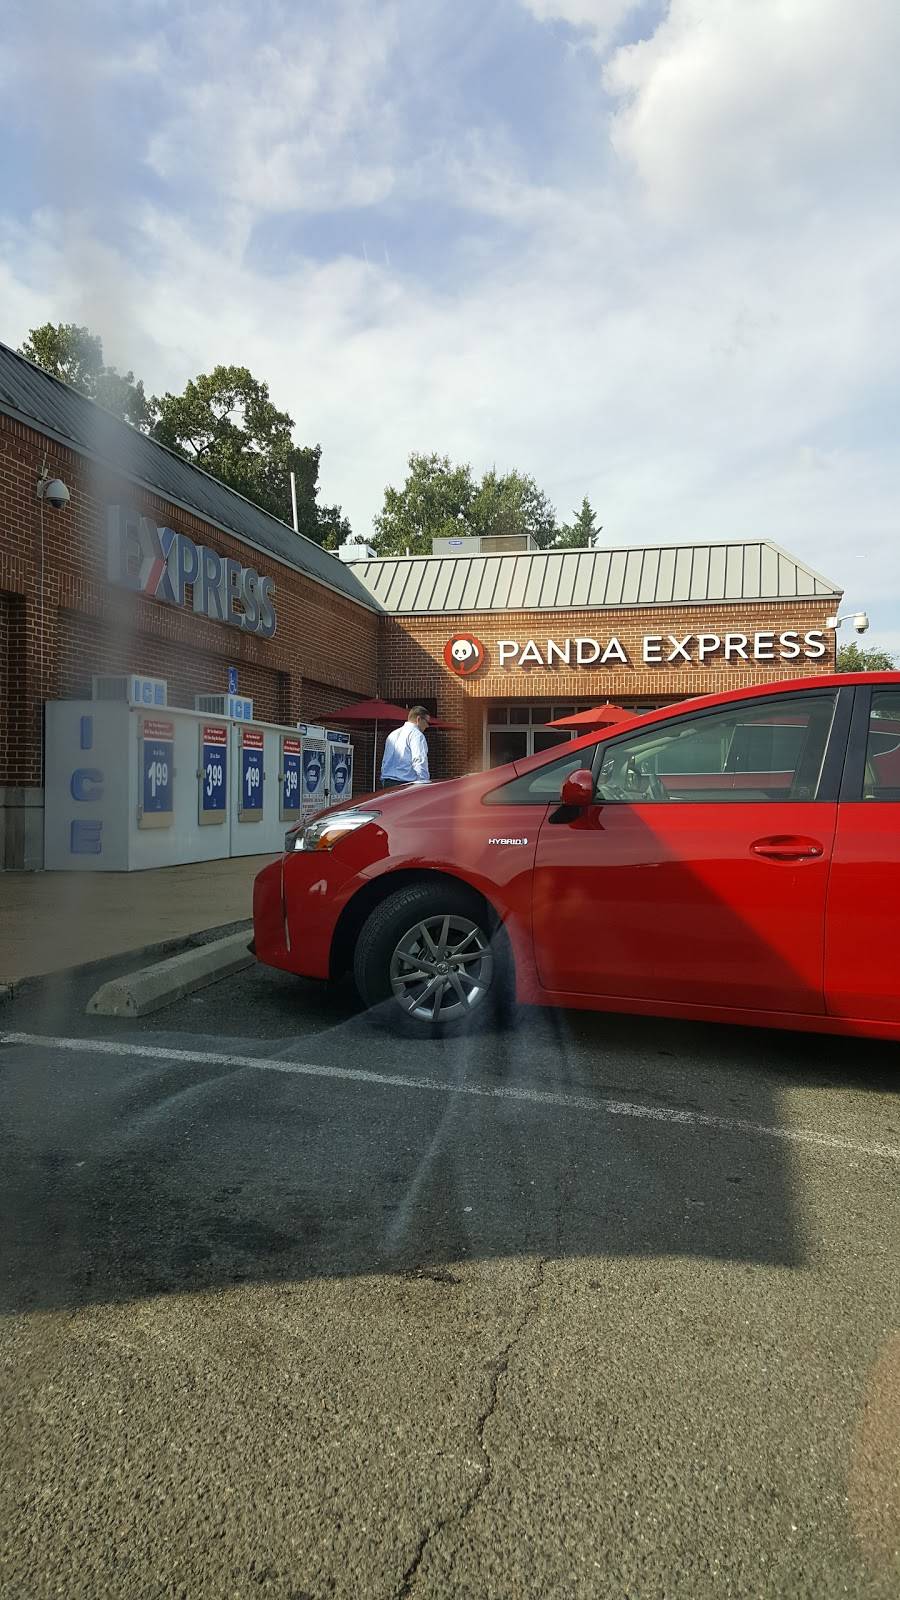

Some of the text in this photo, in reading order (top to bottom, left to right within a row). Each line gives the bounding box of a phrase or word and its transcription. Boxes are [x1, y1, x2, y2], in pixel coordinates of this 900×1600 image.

[107, 504, 277, 638] EXPRESS
[497, 630, 826, 666] PANDA EXPRESS
[134, 679, 166, 705] ICE
[229, 699, 251, 720] ICE
